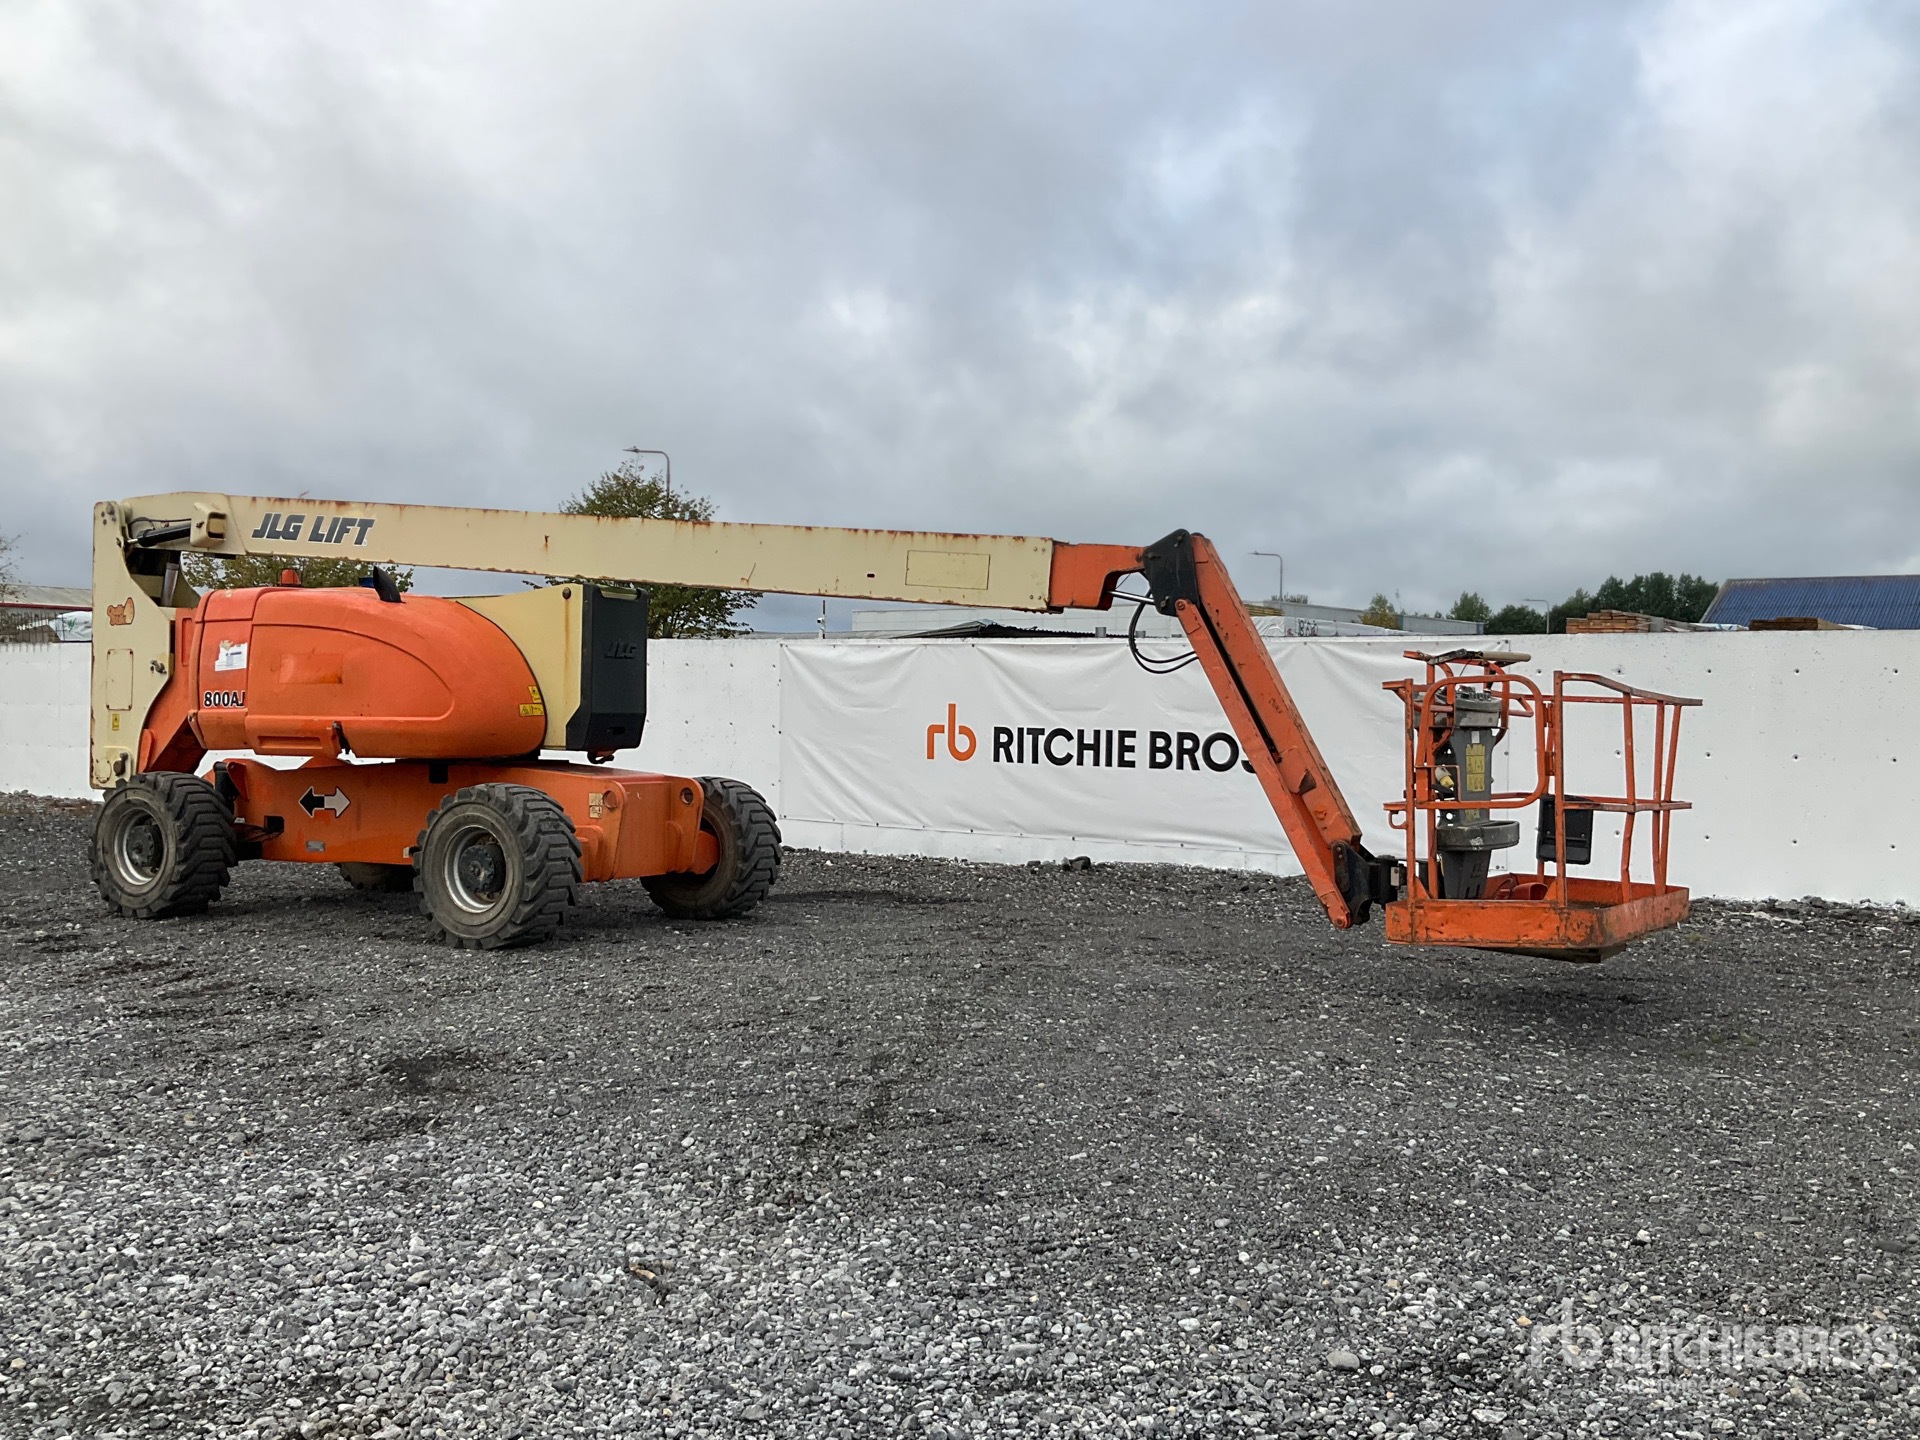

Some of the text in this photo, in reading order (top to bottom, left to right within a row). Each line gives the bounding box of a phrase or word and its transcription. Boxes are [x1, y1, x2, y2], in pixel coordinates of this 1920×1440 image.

[251, 512, 376, 546] JLG LIFT
[203, 690, 246, 708] 800AJ
[926, 702, 978, 763] rb
[992, 725, 1137, 769] RITCHIE
